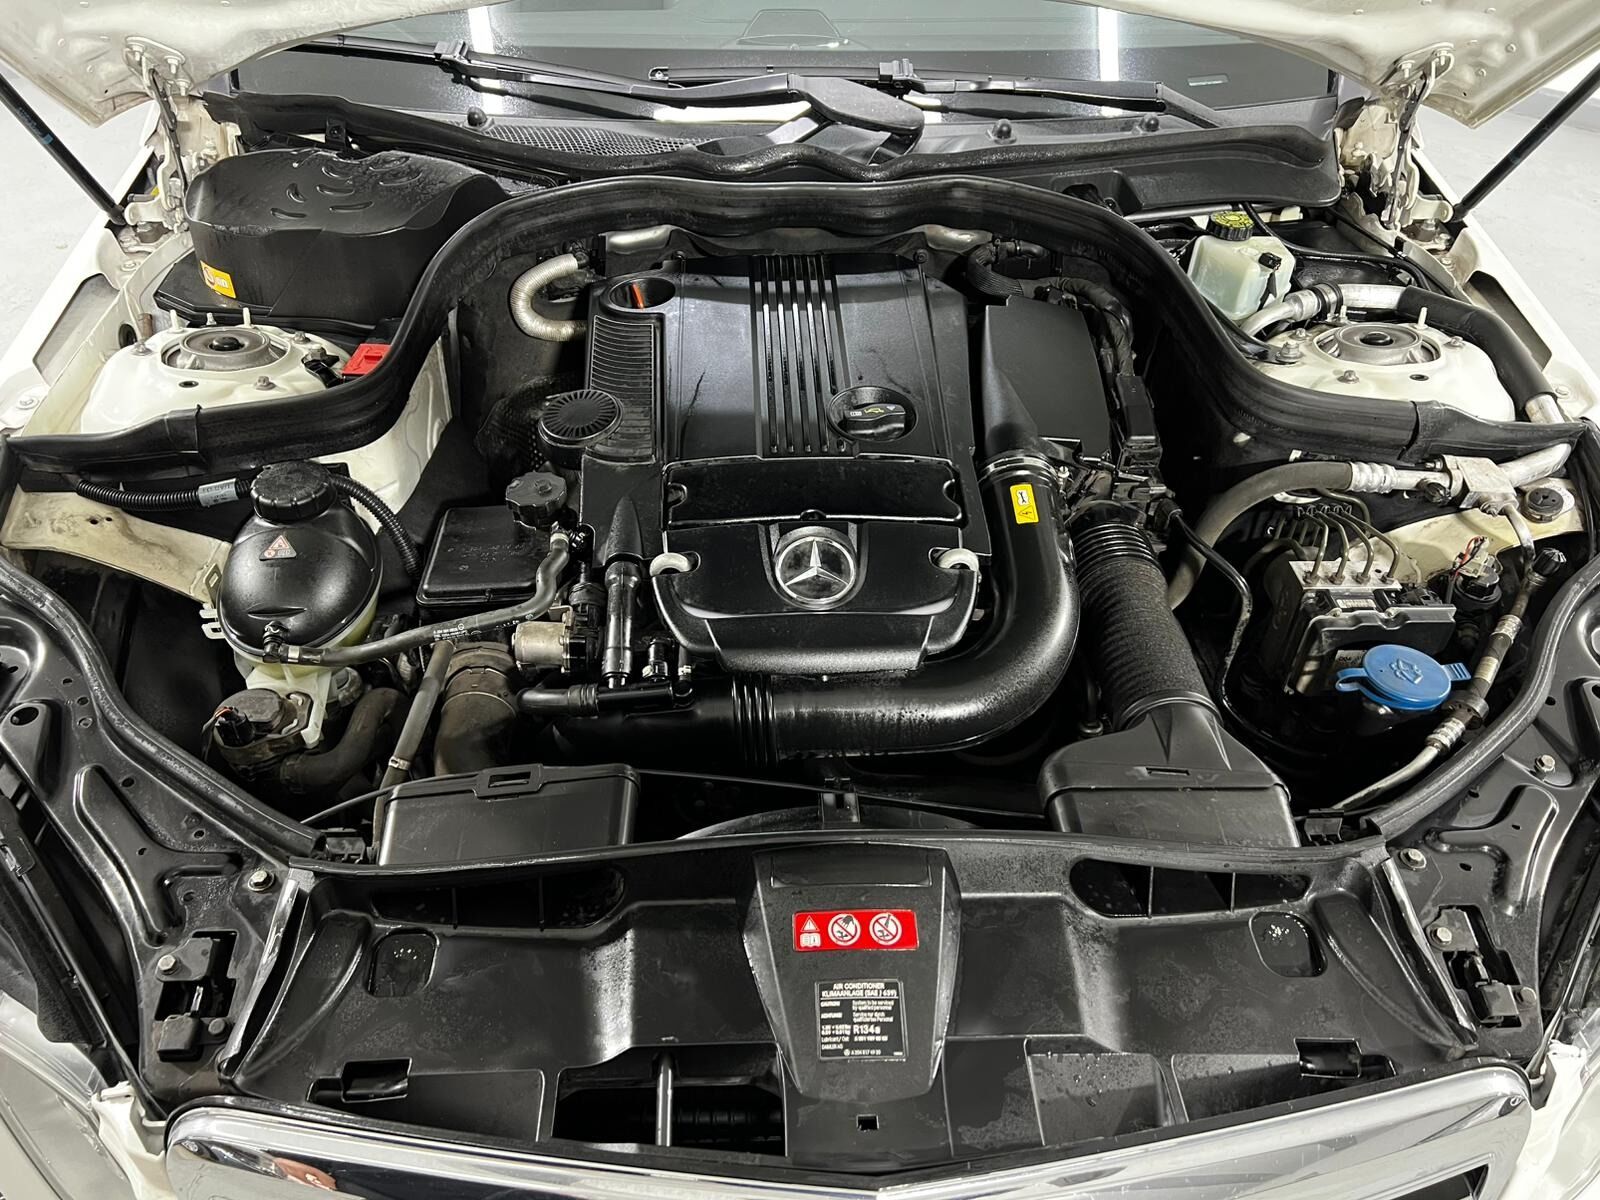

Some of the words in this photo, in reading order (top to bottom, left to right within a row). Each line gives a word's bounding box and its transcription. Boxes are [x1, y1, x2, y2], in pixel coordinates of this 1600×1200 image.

[844, 982, 885, 990] CONDITIONER
[822, 990, 863, 998] KLIMAANLAGE
[853, 1024, 881, 1035] R134a
